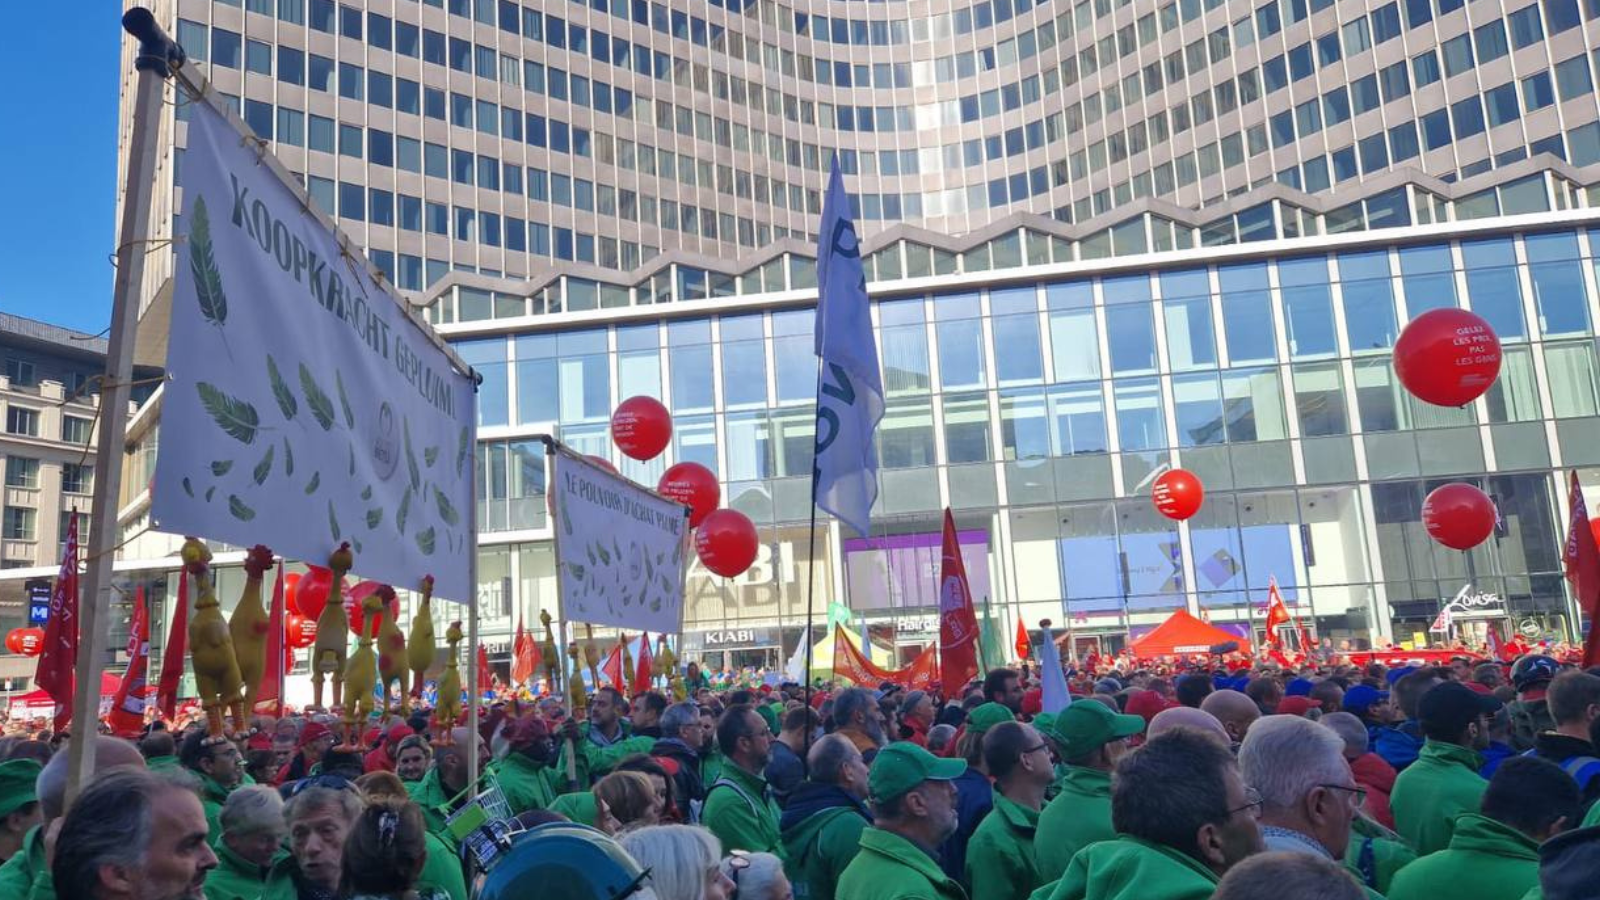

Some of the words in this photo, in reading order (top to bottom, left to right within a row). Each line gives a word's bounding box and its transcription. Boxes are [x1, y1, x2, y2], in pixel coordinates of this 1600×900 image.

[230, 172, 390, 360] KOOPKRACHT
[1469, 345, 1485, 354] PAS
[565, 471, 577, 494] LE
[580, 478, 622, 512] POUVOIR
[686, 541, 796, 587] ABI
[32, 606, 48, 618] M
[1449, 584, 1506, 614] Lovisa
[706, 630, 754, 644] KIABI
